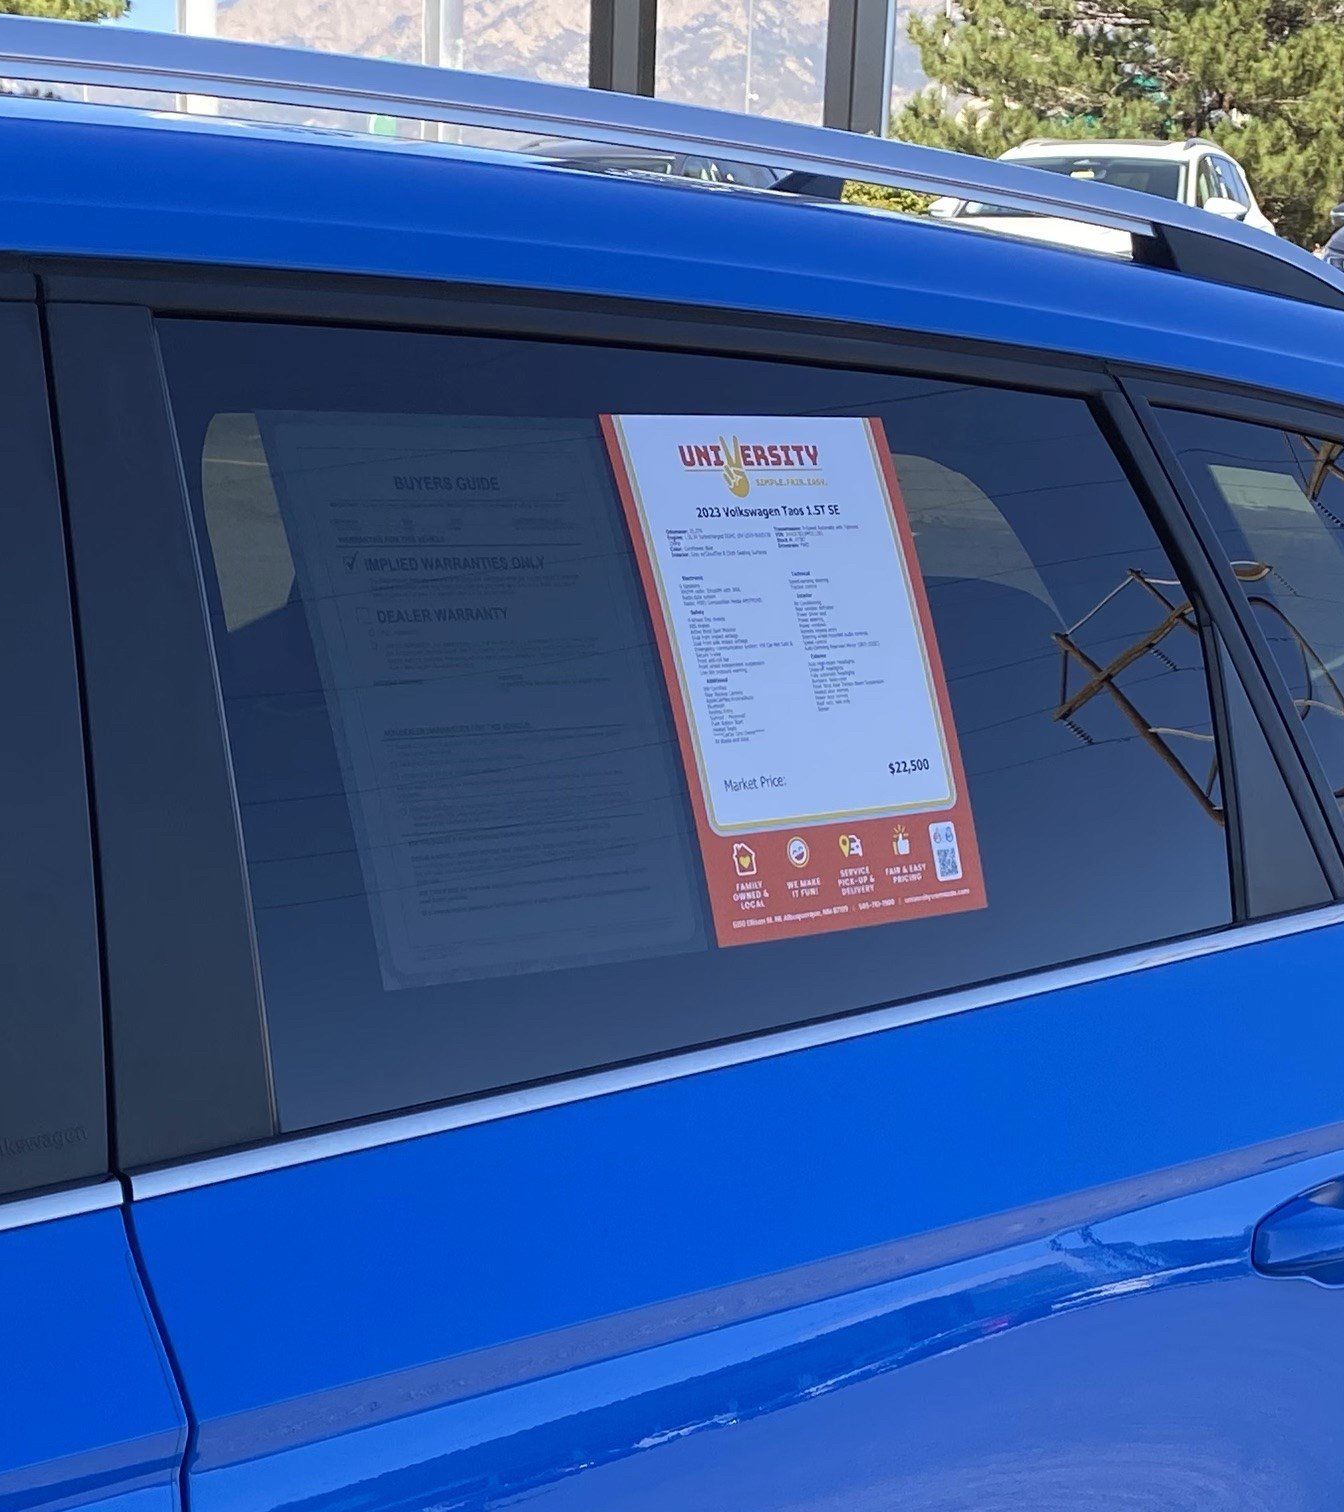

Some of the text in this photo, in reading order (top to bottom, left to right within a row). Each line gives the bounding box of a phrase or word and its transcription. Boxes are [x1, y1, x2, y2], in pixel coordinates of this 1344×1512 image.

[393, 476, 500, 491] BUYERS GUIDE
[696, 504, 841, 519] 2023 Volkswagen Taos 1.5T SE
[364, 556, 545, 572] IMPLIED WARRANTIES ONLY
[377, 607, 507, 623] DEALER WARRANTY
[889, 758, 930, 775] $22,500
[724, 775, 787, 792] Market Price:
[840, 866, 870, 877] SERVICE
[885, 867, 901, 876] FAIR
[909, 863, 926, 873] EASY
[786, 878, 820, 890] WE MAKE
[838, 876, 868, 886] PICK-UP
[893, 873, 922, 884] PRICING
[736, 881, 763, 891] FAMILY
[841, 884, 875, 895] DELIVERY
[733, 890, 761, 901] OWNED
[792, 887, 819, 898] IT FUN!
[741, 900, 765, 910] LOCAL
